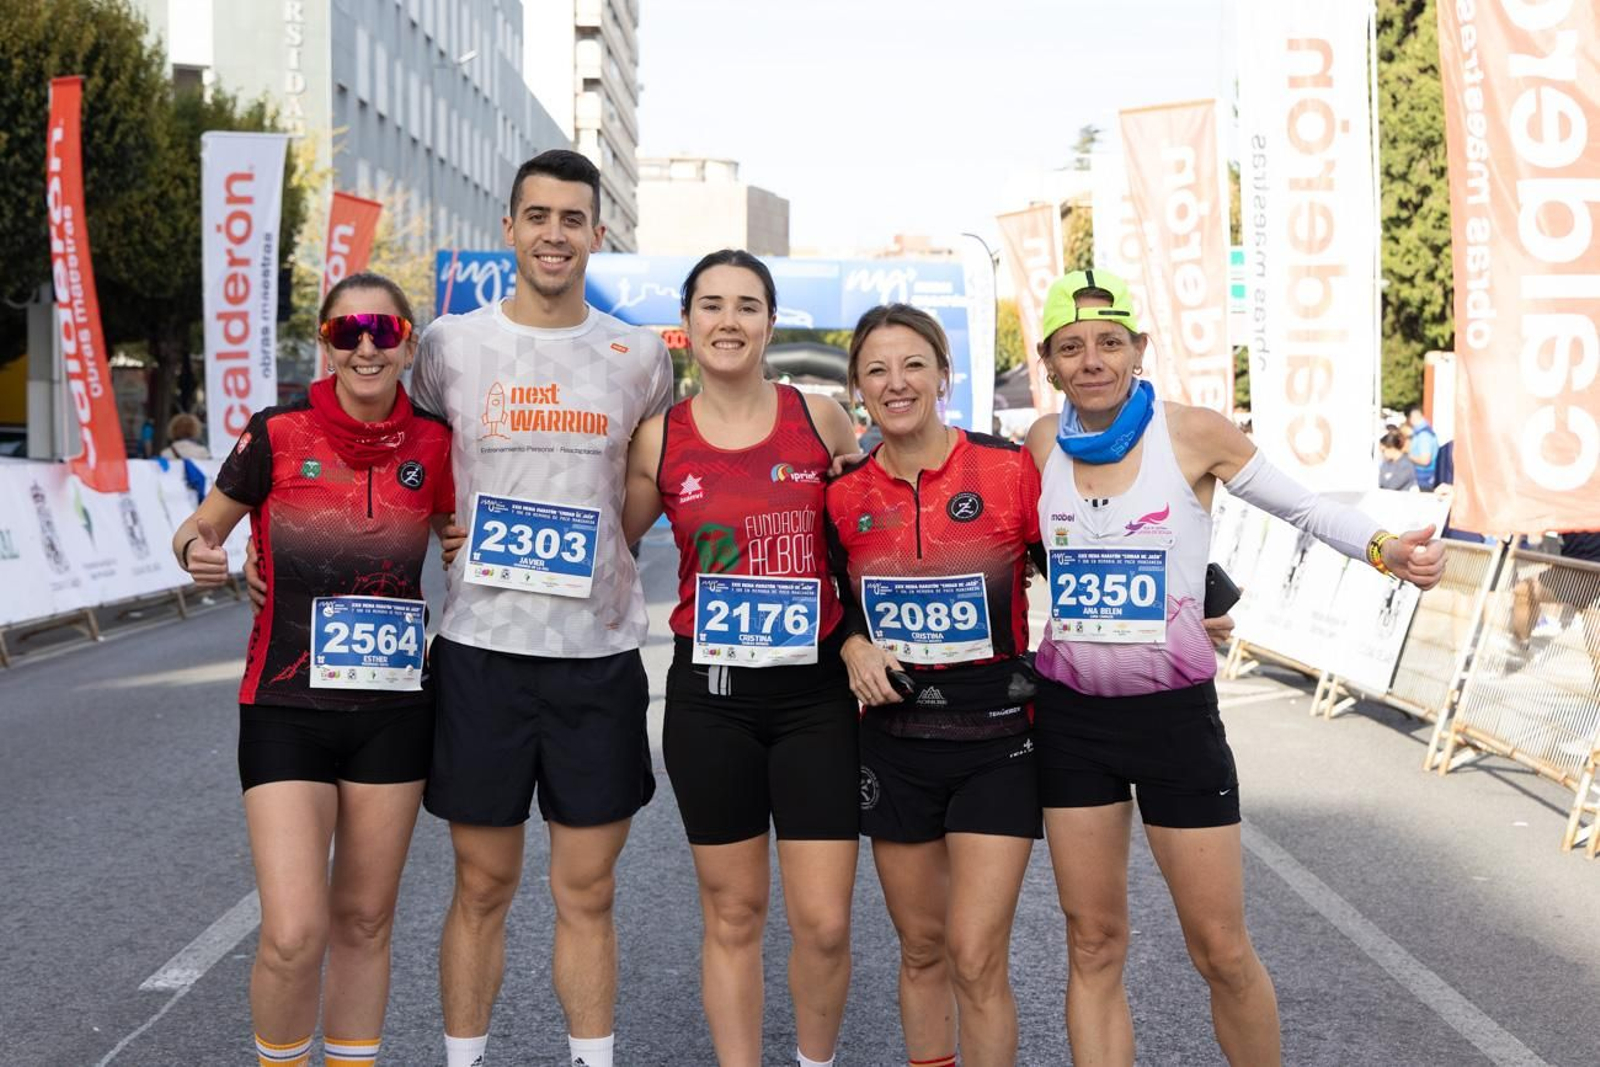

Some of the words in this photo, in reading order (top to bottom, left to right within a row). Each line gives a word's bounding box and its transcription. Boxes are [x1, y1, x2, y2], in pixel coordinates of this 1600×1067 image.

[215, 172, 255, 438] calderón
[259, 324, 271, 379] obras
[510, 383, 560, 404] next
[510, 410, 609, 436] WARRIOR
[745, 504, 816, 539] FUNDACIÓN
[480, 520, 587, 563] 2303
[519, 557, 545, 567] JAVIER
[1057, 573, 1157, 607] 2350
[705, 600, 809, 635] 2176
[875, 601, 978, 631] 2089
[1083, 607, 1098, 615] ANA
[321, 622, 418, 656] 2564
[739, 634, 772, 642] CRISTINA
[911, 632, 944, 640] CRISTINA
[363, 655, 388, 663] ESTHER
